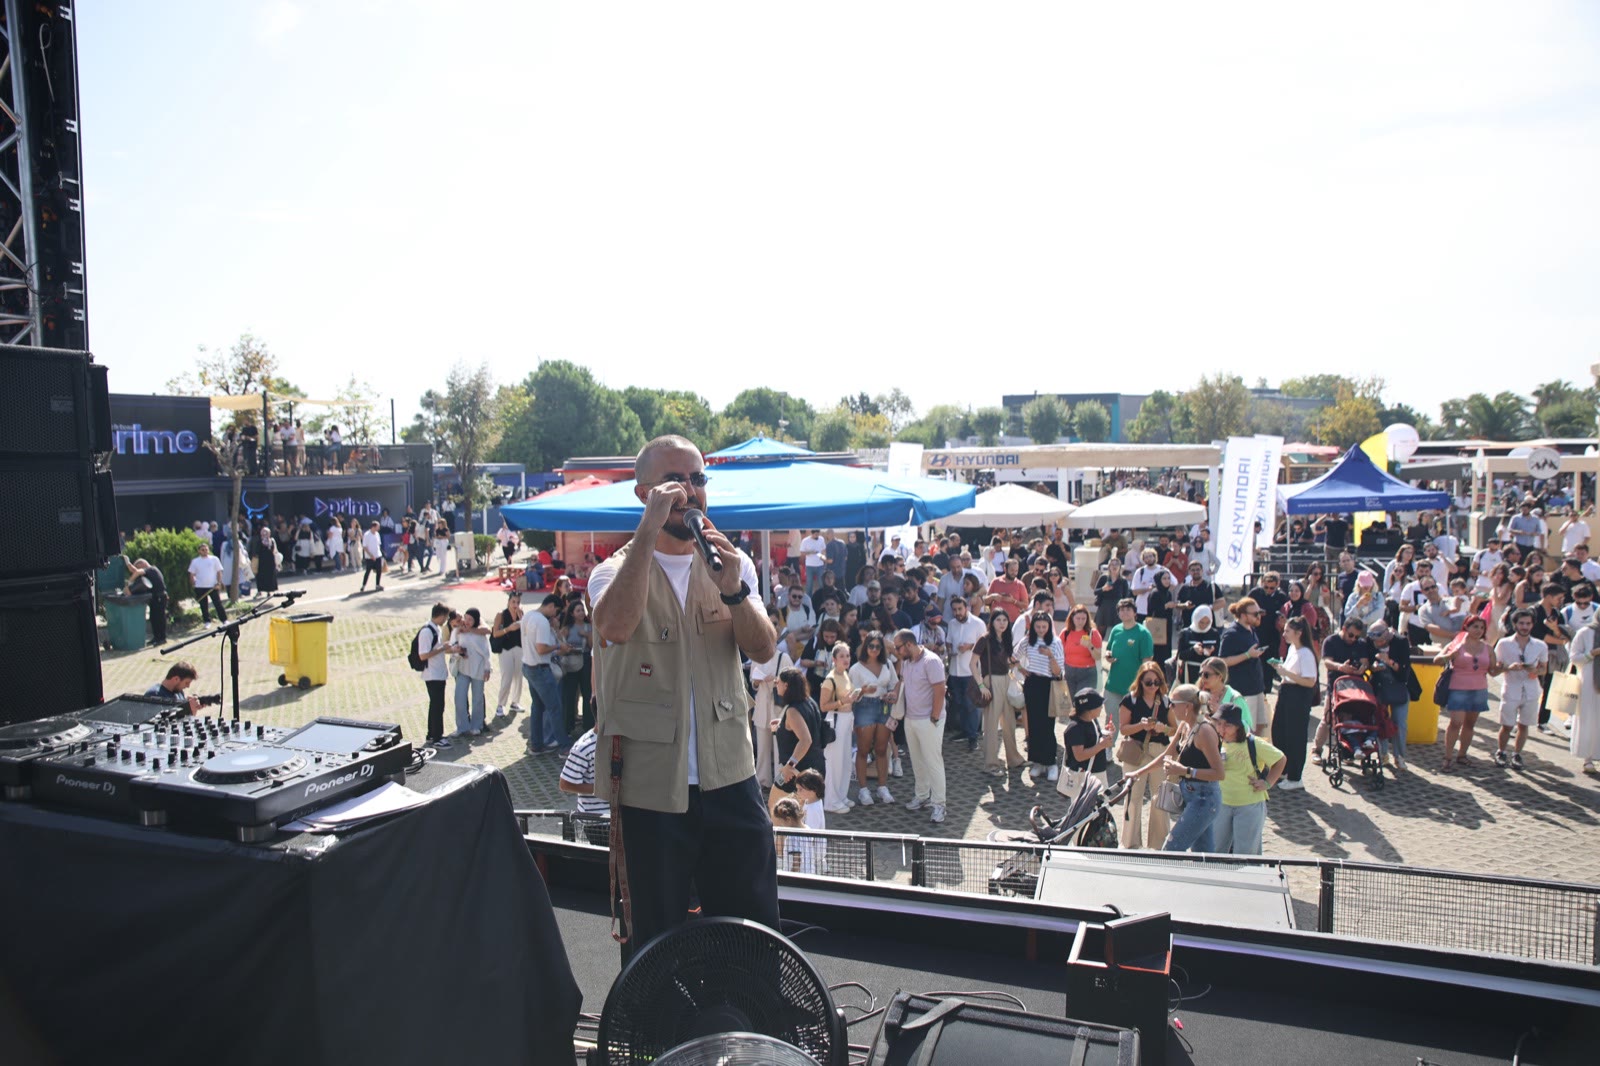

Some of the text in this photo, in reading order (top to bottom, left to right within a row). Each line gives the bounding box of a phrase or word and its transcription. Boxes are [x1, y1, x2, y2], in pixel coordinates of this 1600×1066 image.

[112, 424, 198, 454] rime
[956, 454, 1019, 466] HYUNDAI
[329, 497, 381, 517] prime
[1232, 457, 1251, 535] HYUNDAI
[56, 773, 101, 790] Pioneer
[303, 771, 358, 798] Pioneer
